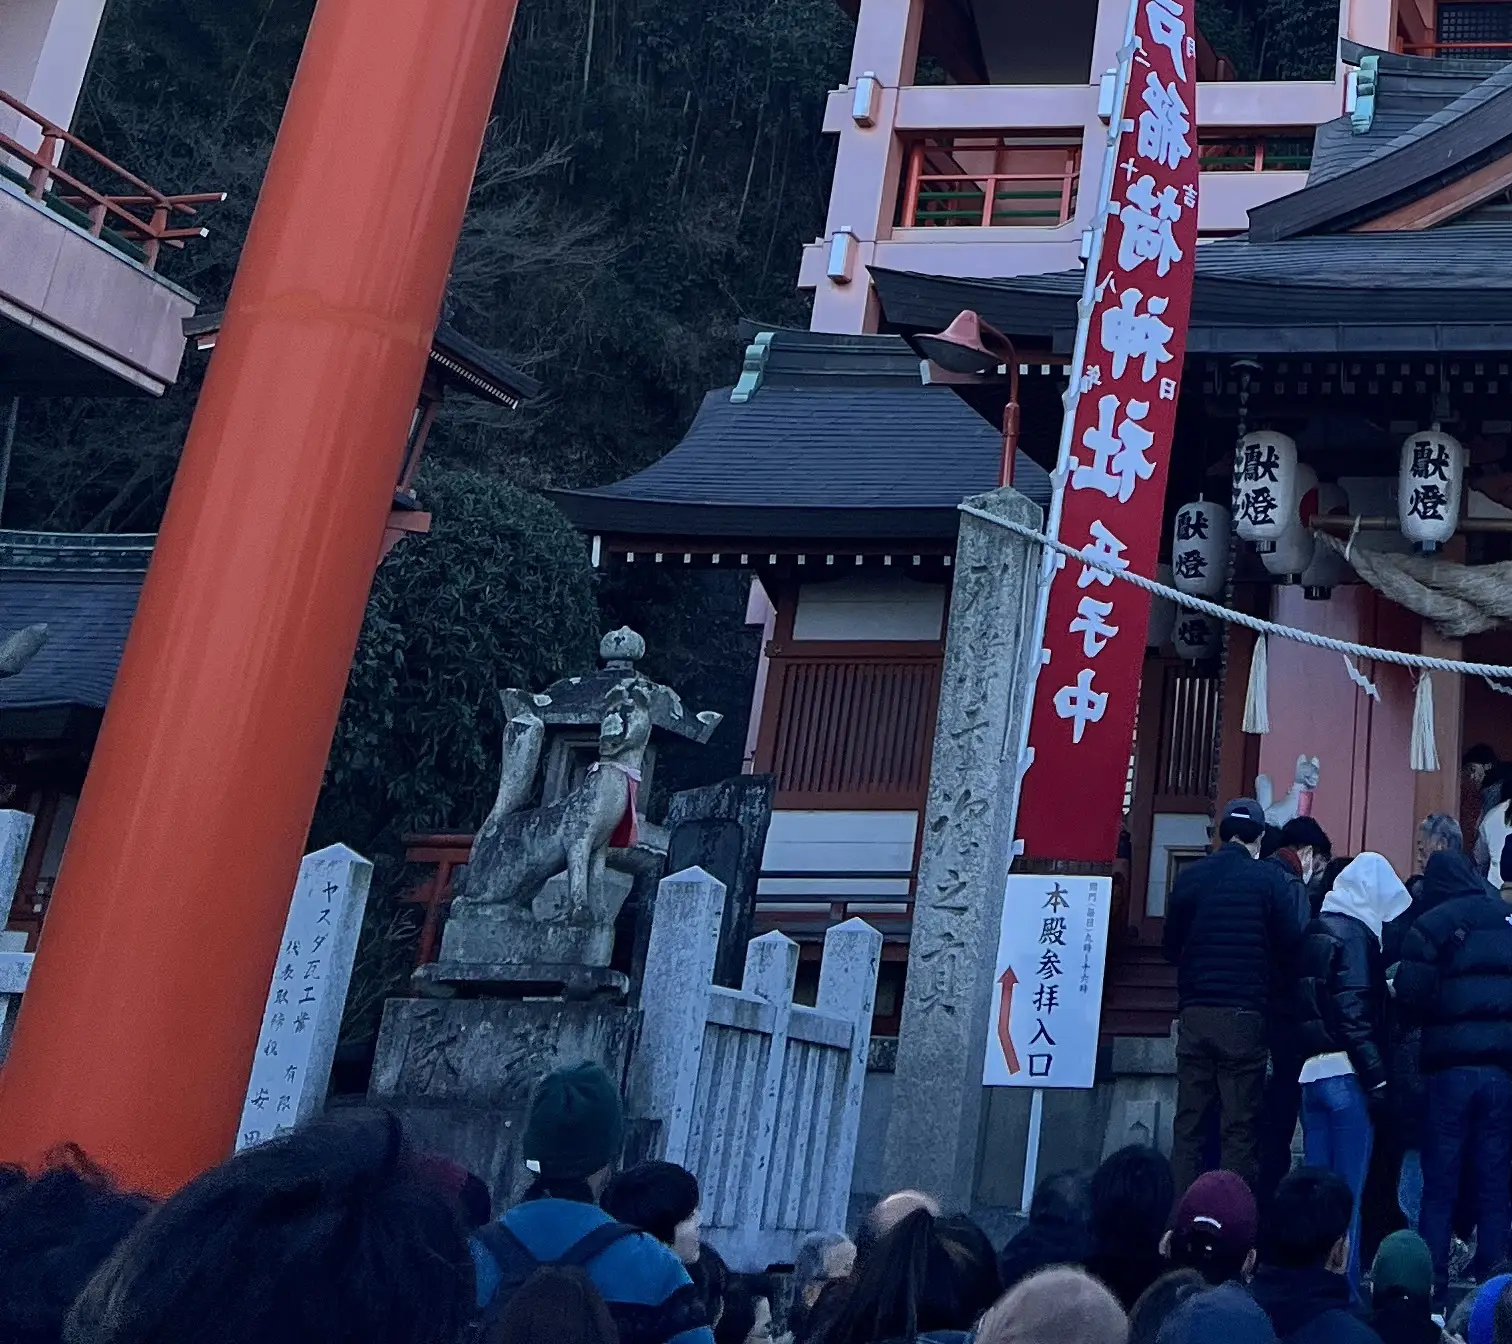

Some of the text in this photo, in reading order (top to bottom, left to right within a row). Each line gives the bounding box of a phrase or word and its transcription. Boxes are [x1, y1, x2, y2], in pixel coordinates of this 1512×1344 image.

[1027, 881, 1070, 1078] 本殿参拝入口
